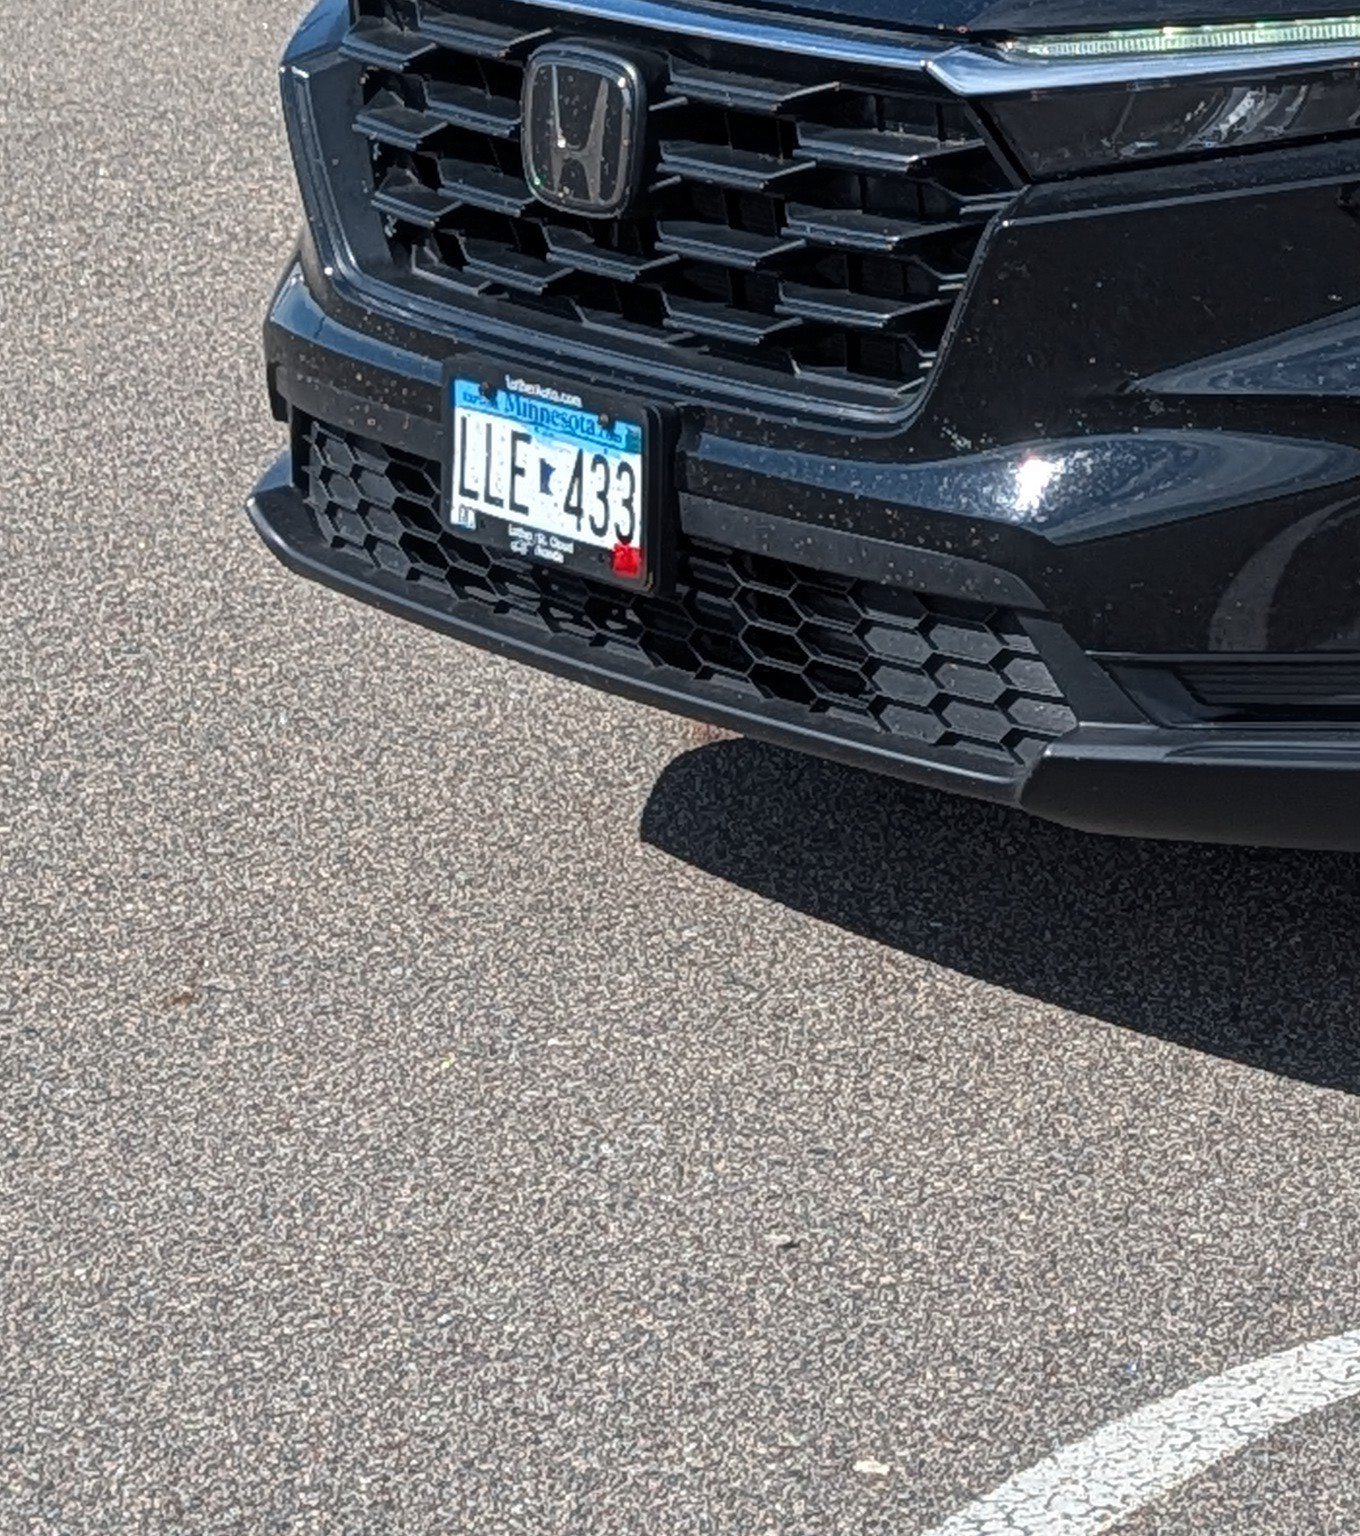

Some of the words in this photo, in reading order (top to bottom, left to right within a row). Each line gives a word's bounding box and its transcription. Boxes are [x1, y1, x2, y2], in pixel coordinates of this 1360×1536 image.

[505, 393, 595, 435] Minnesota
[458, 415, 532, 516] LLE
[563, 448, 637, 545] 433
